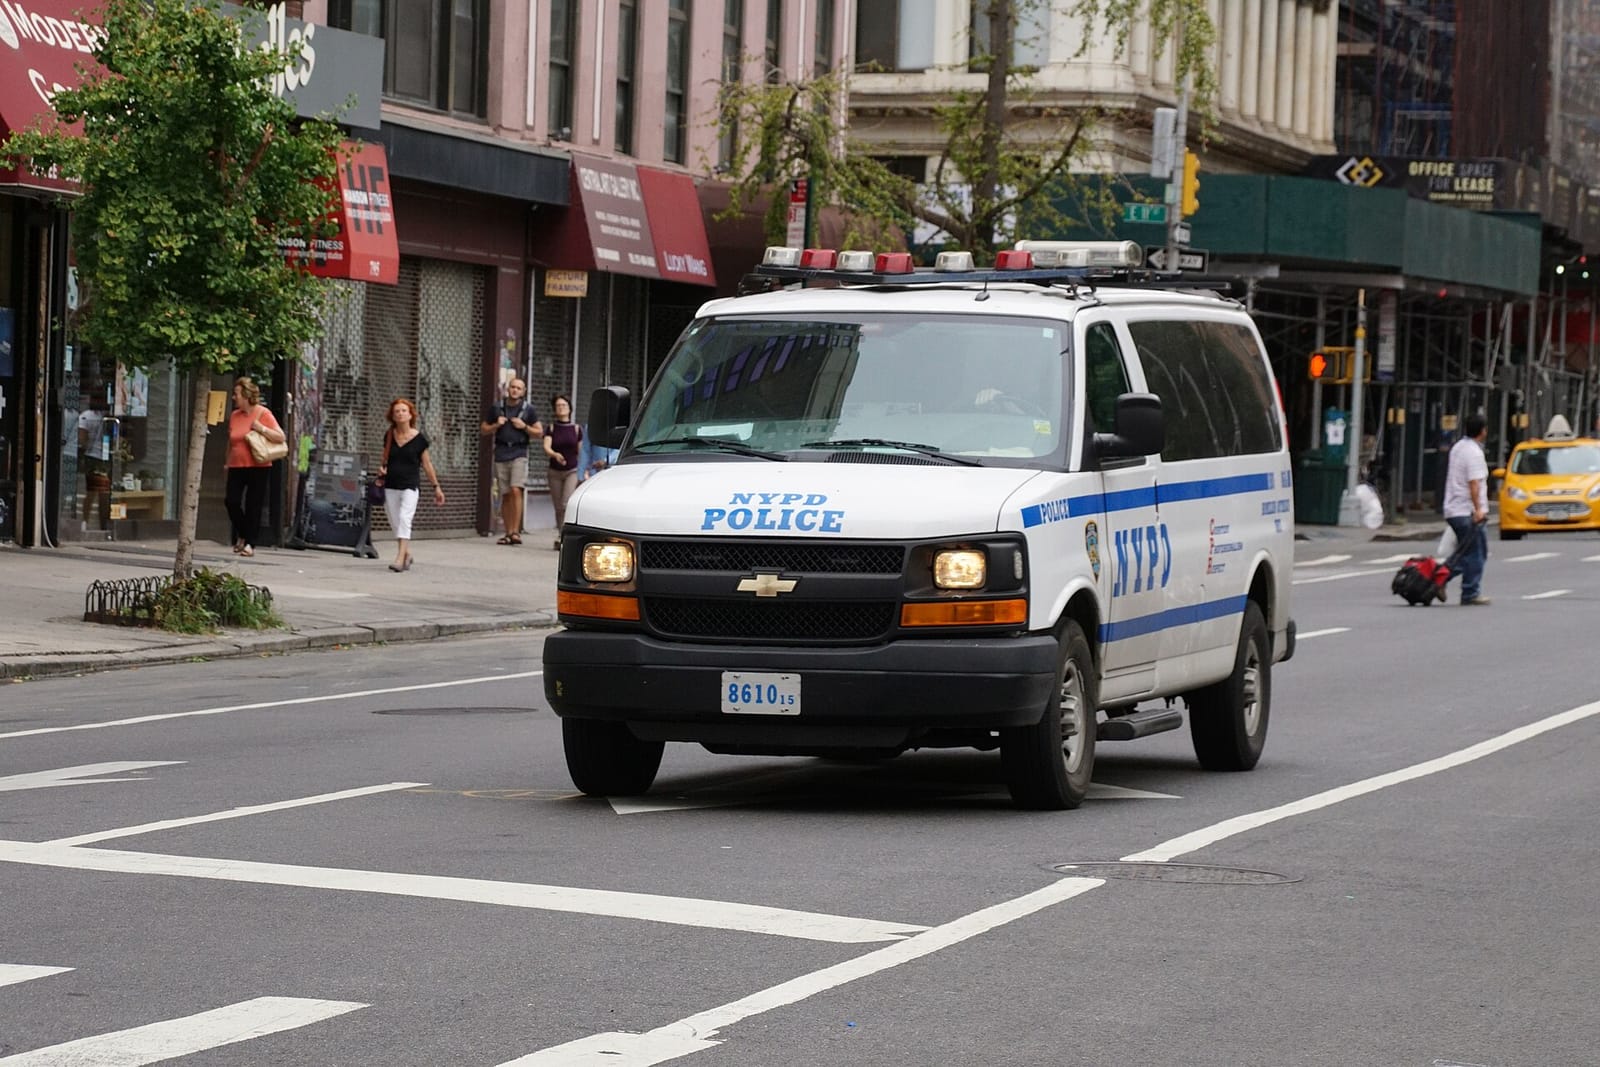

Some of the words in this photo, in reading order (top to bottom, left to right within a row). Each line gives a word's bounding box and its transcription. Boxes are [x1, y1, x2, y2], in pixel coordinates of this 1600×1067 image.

[1409, 161, 1455, 176] OFFICE
[1460, 163, 1495, 176] SPACE
[1454, 178, 1495, 192] LEASE
[309, 239, 344, 251] FITNESS
[729, 493, 828, 506] NYPD
[701, 508, 845, 533] POLICE
[1113, 523, 1172, 598] NYPD
[728, 683, 778, 704] 8610
[780, 694, 795, 705] 15
